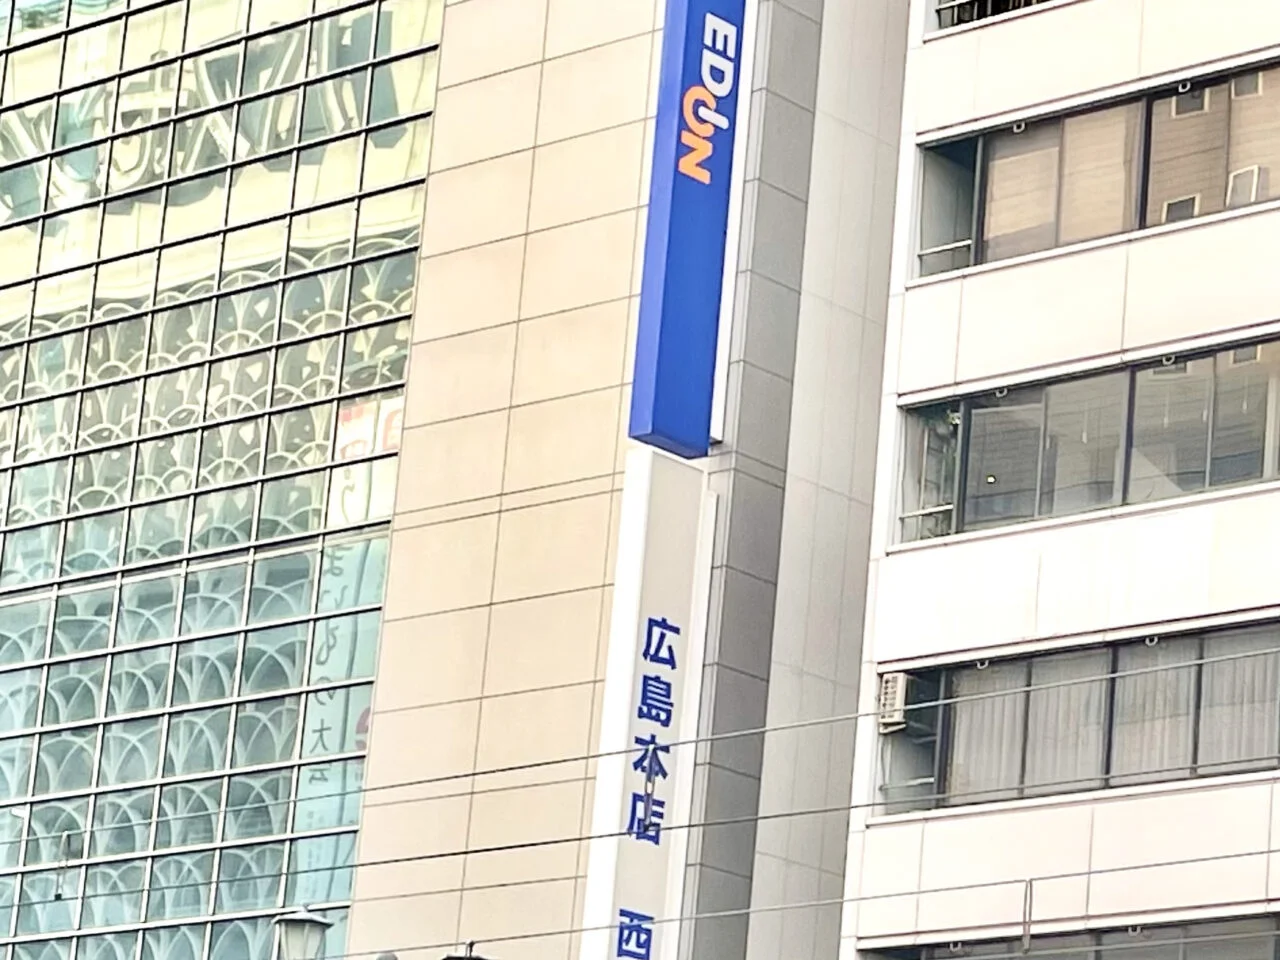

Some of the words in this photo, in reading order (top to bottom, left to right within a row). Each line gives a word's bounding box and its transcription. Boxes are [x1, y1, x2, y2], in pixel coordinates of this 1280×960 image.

[678, 12, 738, 185] EDION
[626, 616, 681, 846] 広島本店
